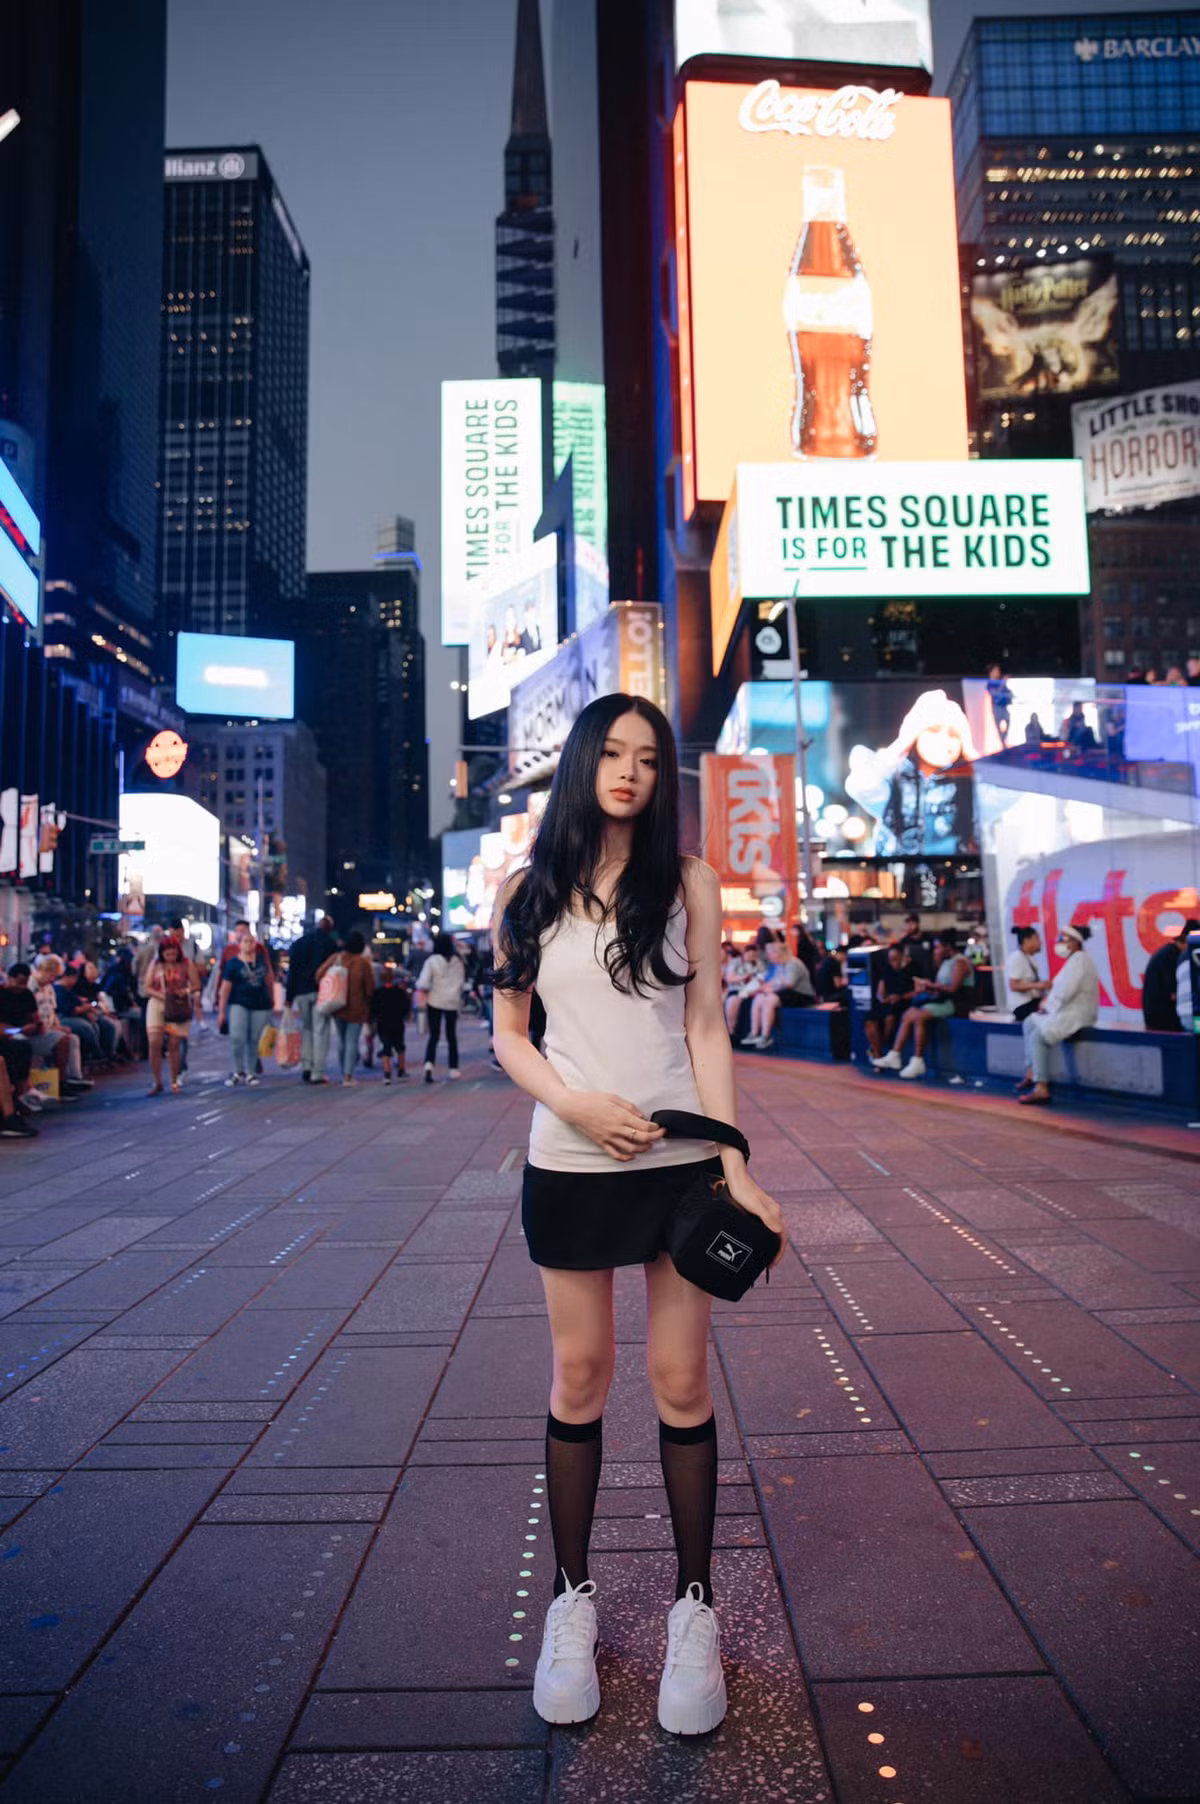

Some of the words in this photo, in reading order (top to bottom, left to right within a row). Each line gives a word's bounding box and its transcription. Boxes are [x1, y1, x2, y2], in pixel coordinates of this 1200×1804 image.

[165, 157, 216, 177] llianz
[494, 399, 518, 455] KIDS
[1089, 395, 1155, 438] LITTLE
[465, 399, 488, 497] SQUARE
[1089, 427, 1200, 496] HORROR
[495, 466, 518, 511] THE
[776, 496, 888, 529] TIMES
[900, 494, 1050, 528] SQUARE
[466, 507, 489, 581] TIMES
[782, 536, 806, 560] IS
[816, 536, 867, 560] FOR
[881, 535, 950, 569] THE
[964, 533, 1051, 568] KIDS
[627, 611, 653, 697] ELLO!
